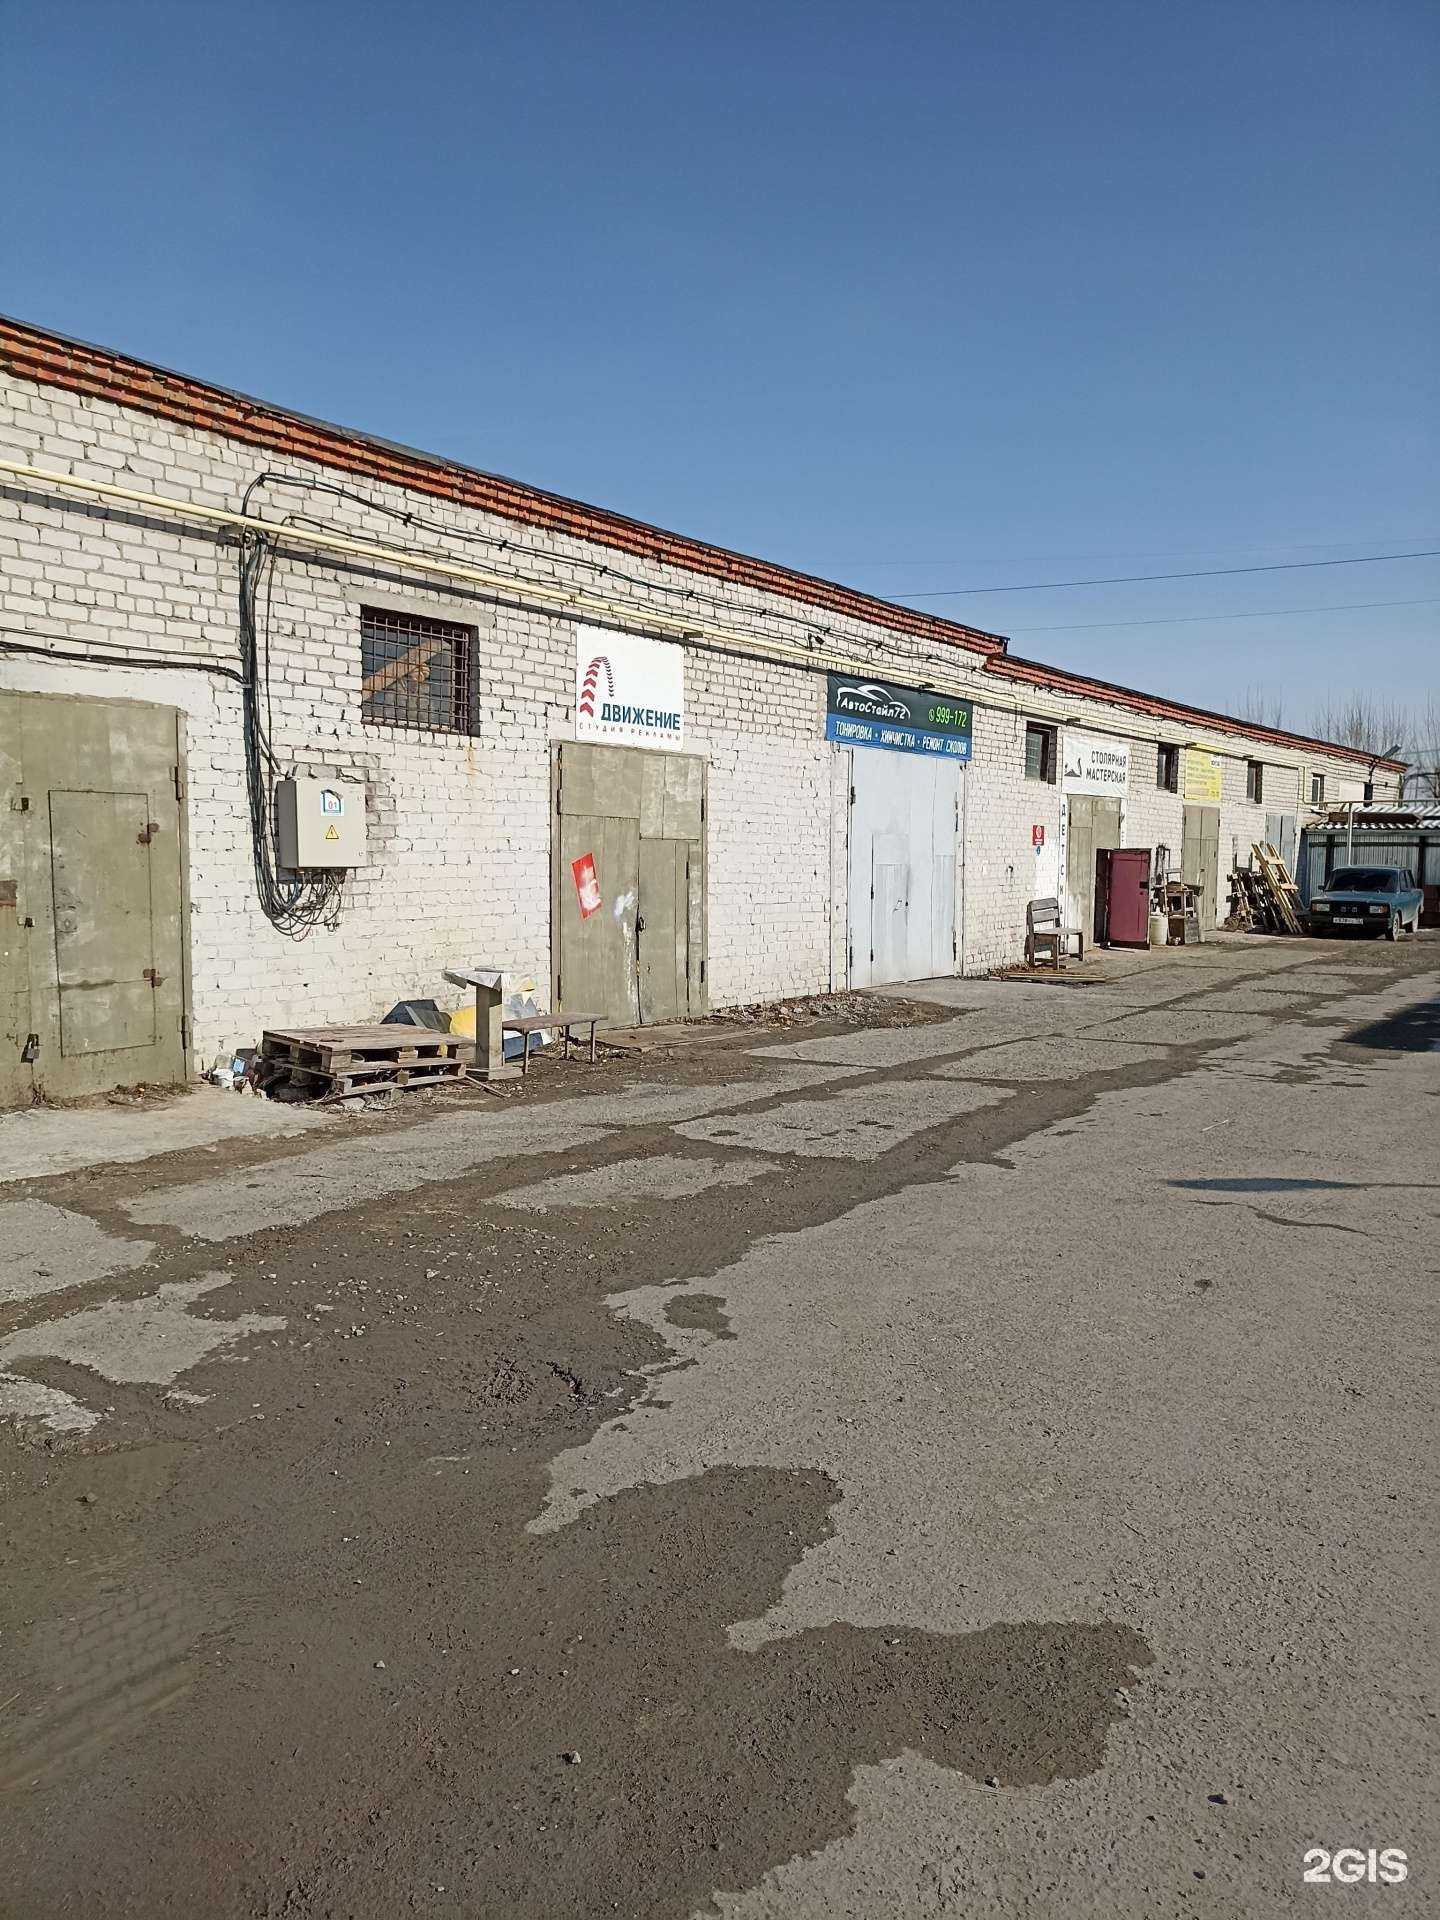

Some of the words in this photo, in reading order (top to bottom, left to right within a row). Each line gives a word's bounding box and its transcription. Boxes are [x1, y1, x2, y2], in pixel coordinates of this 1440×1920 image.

[601, 703, 681, 730] ДВИЖЕНИЕ
[840, 697, 906, 719] АвтоСтайл72
[936, 706, 967, 728] 999-172
[835, 721, 872, 741] ТОНИРОВКА
[880, 730, 915, 748] ХИМЧИСТКА
[922, 736, 945, 751] РЕМОНТ
[1091, 750, 1127, 767] СТОЛЯРНАЯ
[1086, 767, 1127, 784] МАСТЕРСКАЯ
